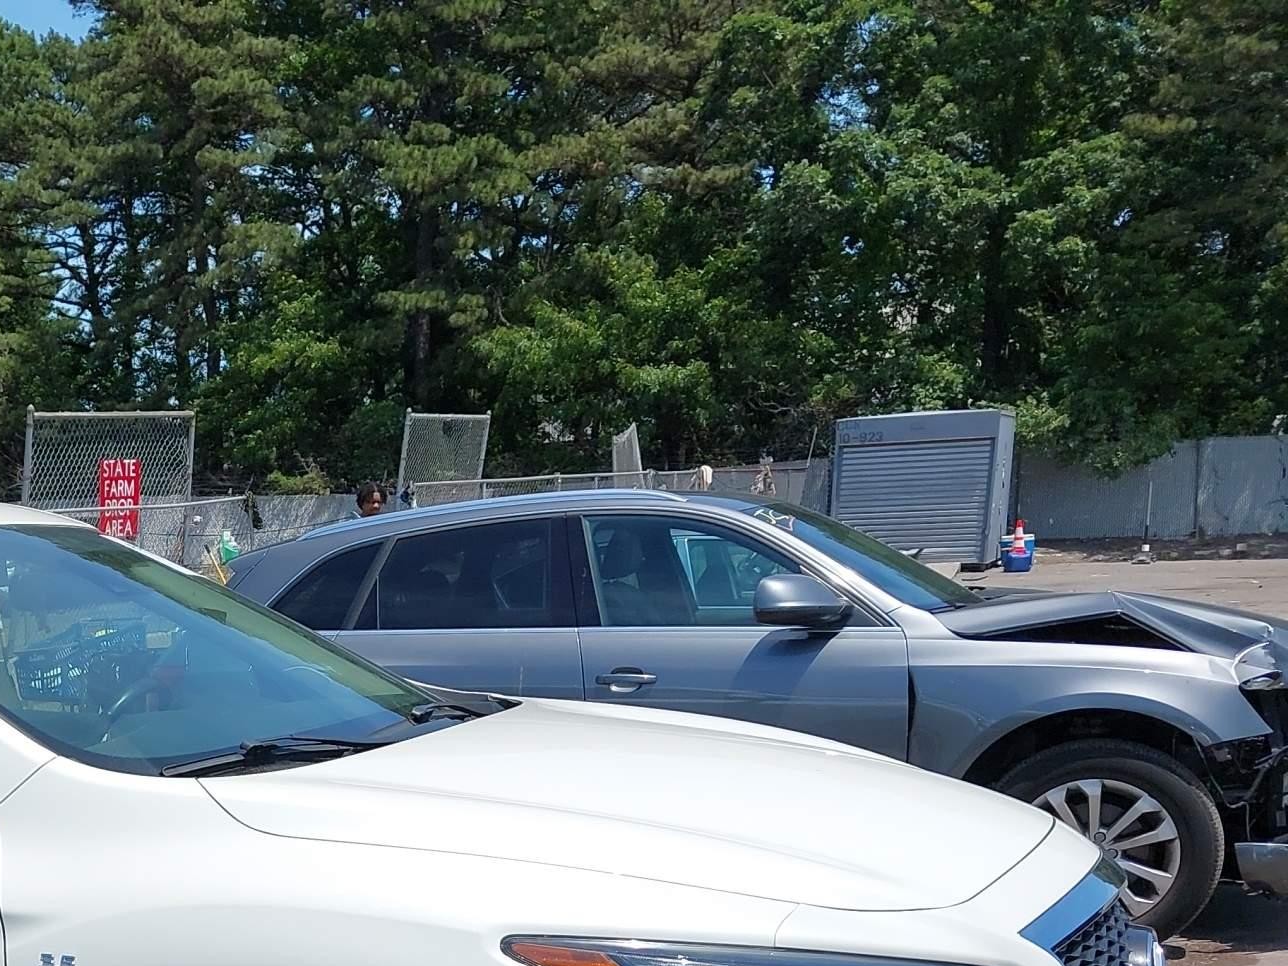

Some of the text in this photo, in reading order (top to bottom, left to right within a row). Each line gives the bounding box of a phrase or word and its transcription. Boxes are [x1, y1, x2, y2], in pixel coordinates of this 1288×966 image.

[102, 459, 137, 478] STATE
[104, 479, 135, 498] FARM
[104, 499, 134, 517] DROP
[105, 519, 133, 537] AREA
